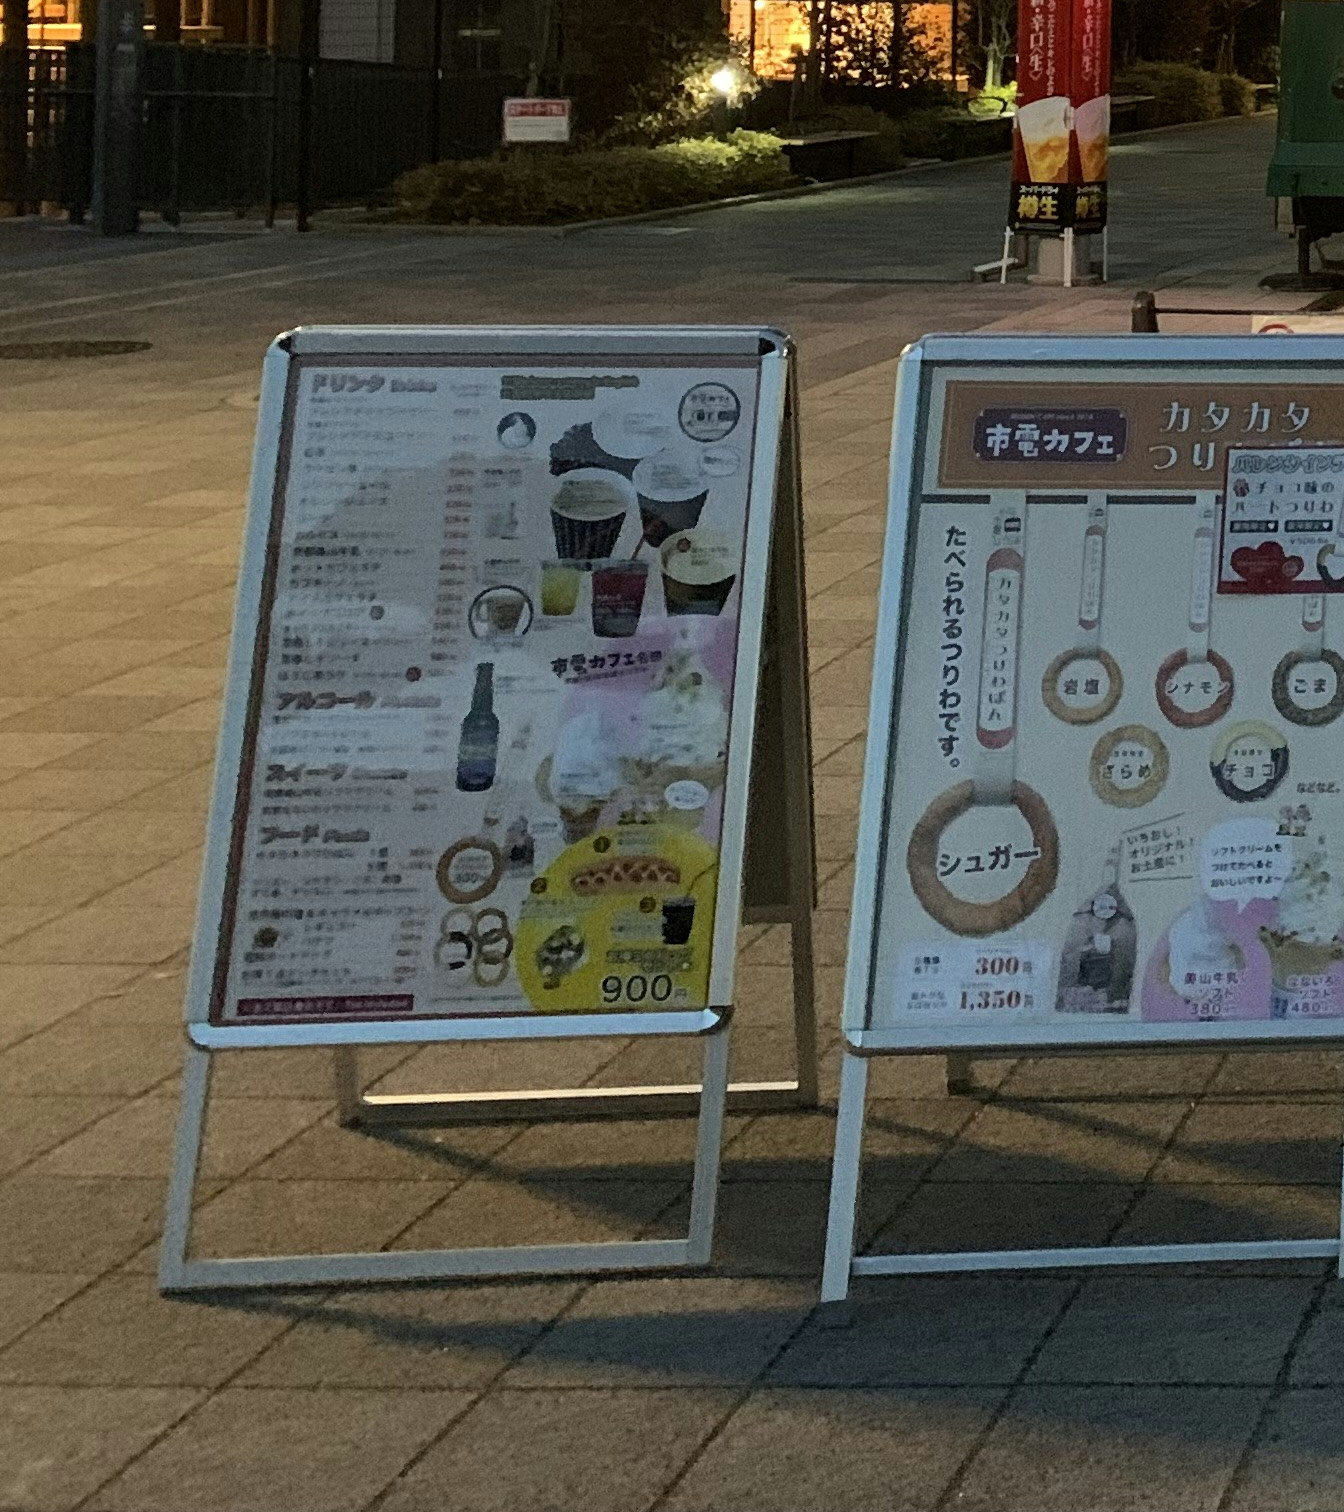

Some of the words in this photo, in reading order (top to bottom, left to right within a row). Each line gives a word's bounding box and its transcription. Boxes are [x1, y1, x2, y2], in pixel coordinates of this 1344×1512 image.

[1159, 401, 1310, 433] カタカタ
[985, 422, 1114, 457] 市電カフェ
[938, 525, 967, 769] たべられるつりわです。
[1063, 678, 1100, 696] 岩塩
[1166, 681, 1231, 696] シナモン
[1293, 677, 1328, 695] ごま
[1224, 763, 1274, 779] チョコ
[938, 843, 1040, 877] シュガー
